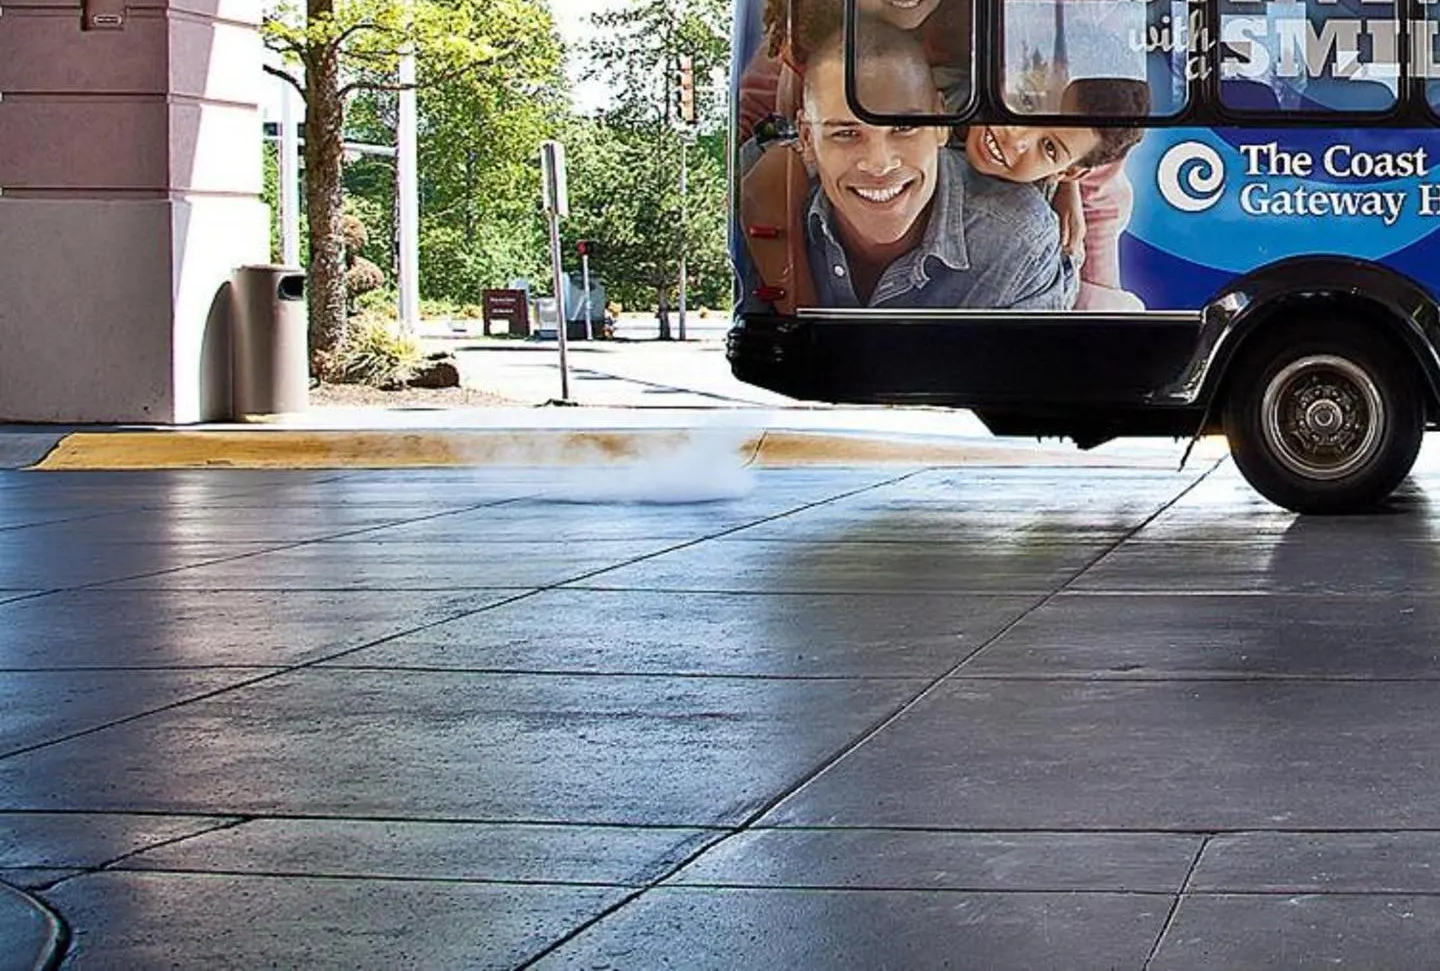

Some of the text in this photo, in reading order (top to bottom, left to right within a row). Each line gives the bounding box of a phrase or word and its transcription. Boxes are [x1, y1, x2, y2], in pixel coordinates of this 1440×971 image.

[1128, 9, 1217, 53] with
[1184, 53, 1211, 82] a
[1240, 142, 1428, 178] The Coast
[1240, 183, 1406, 224] Gateway
